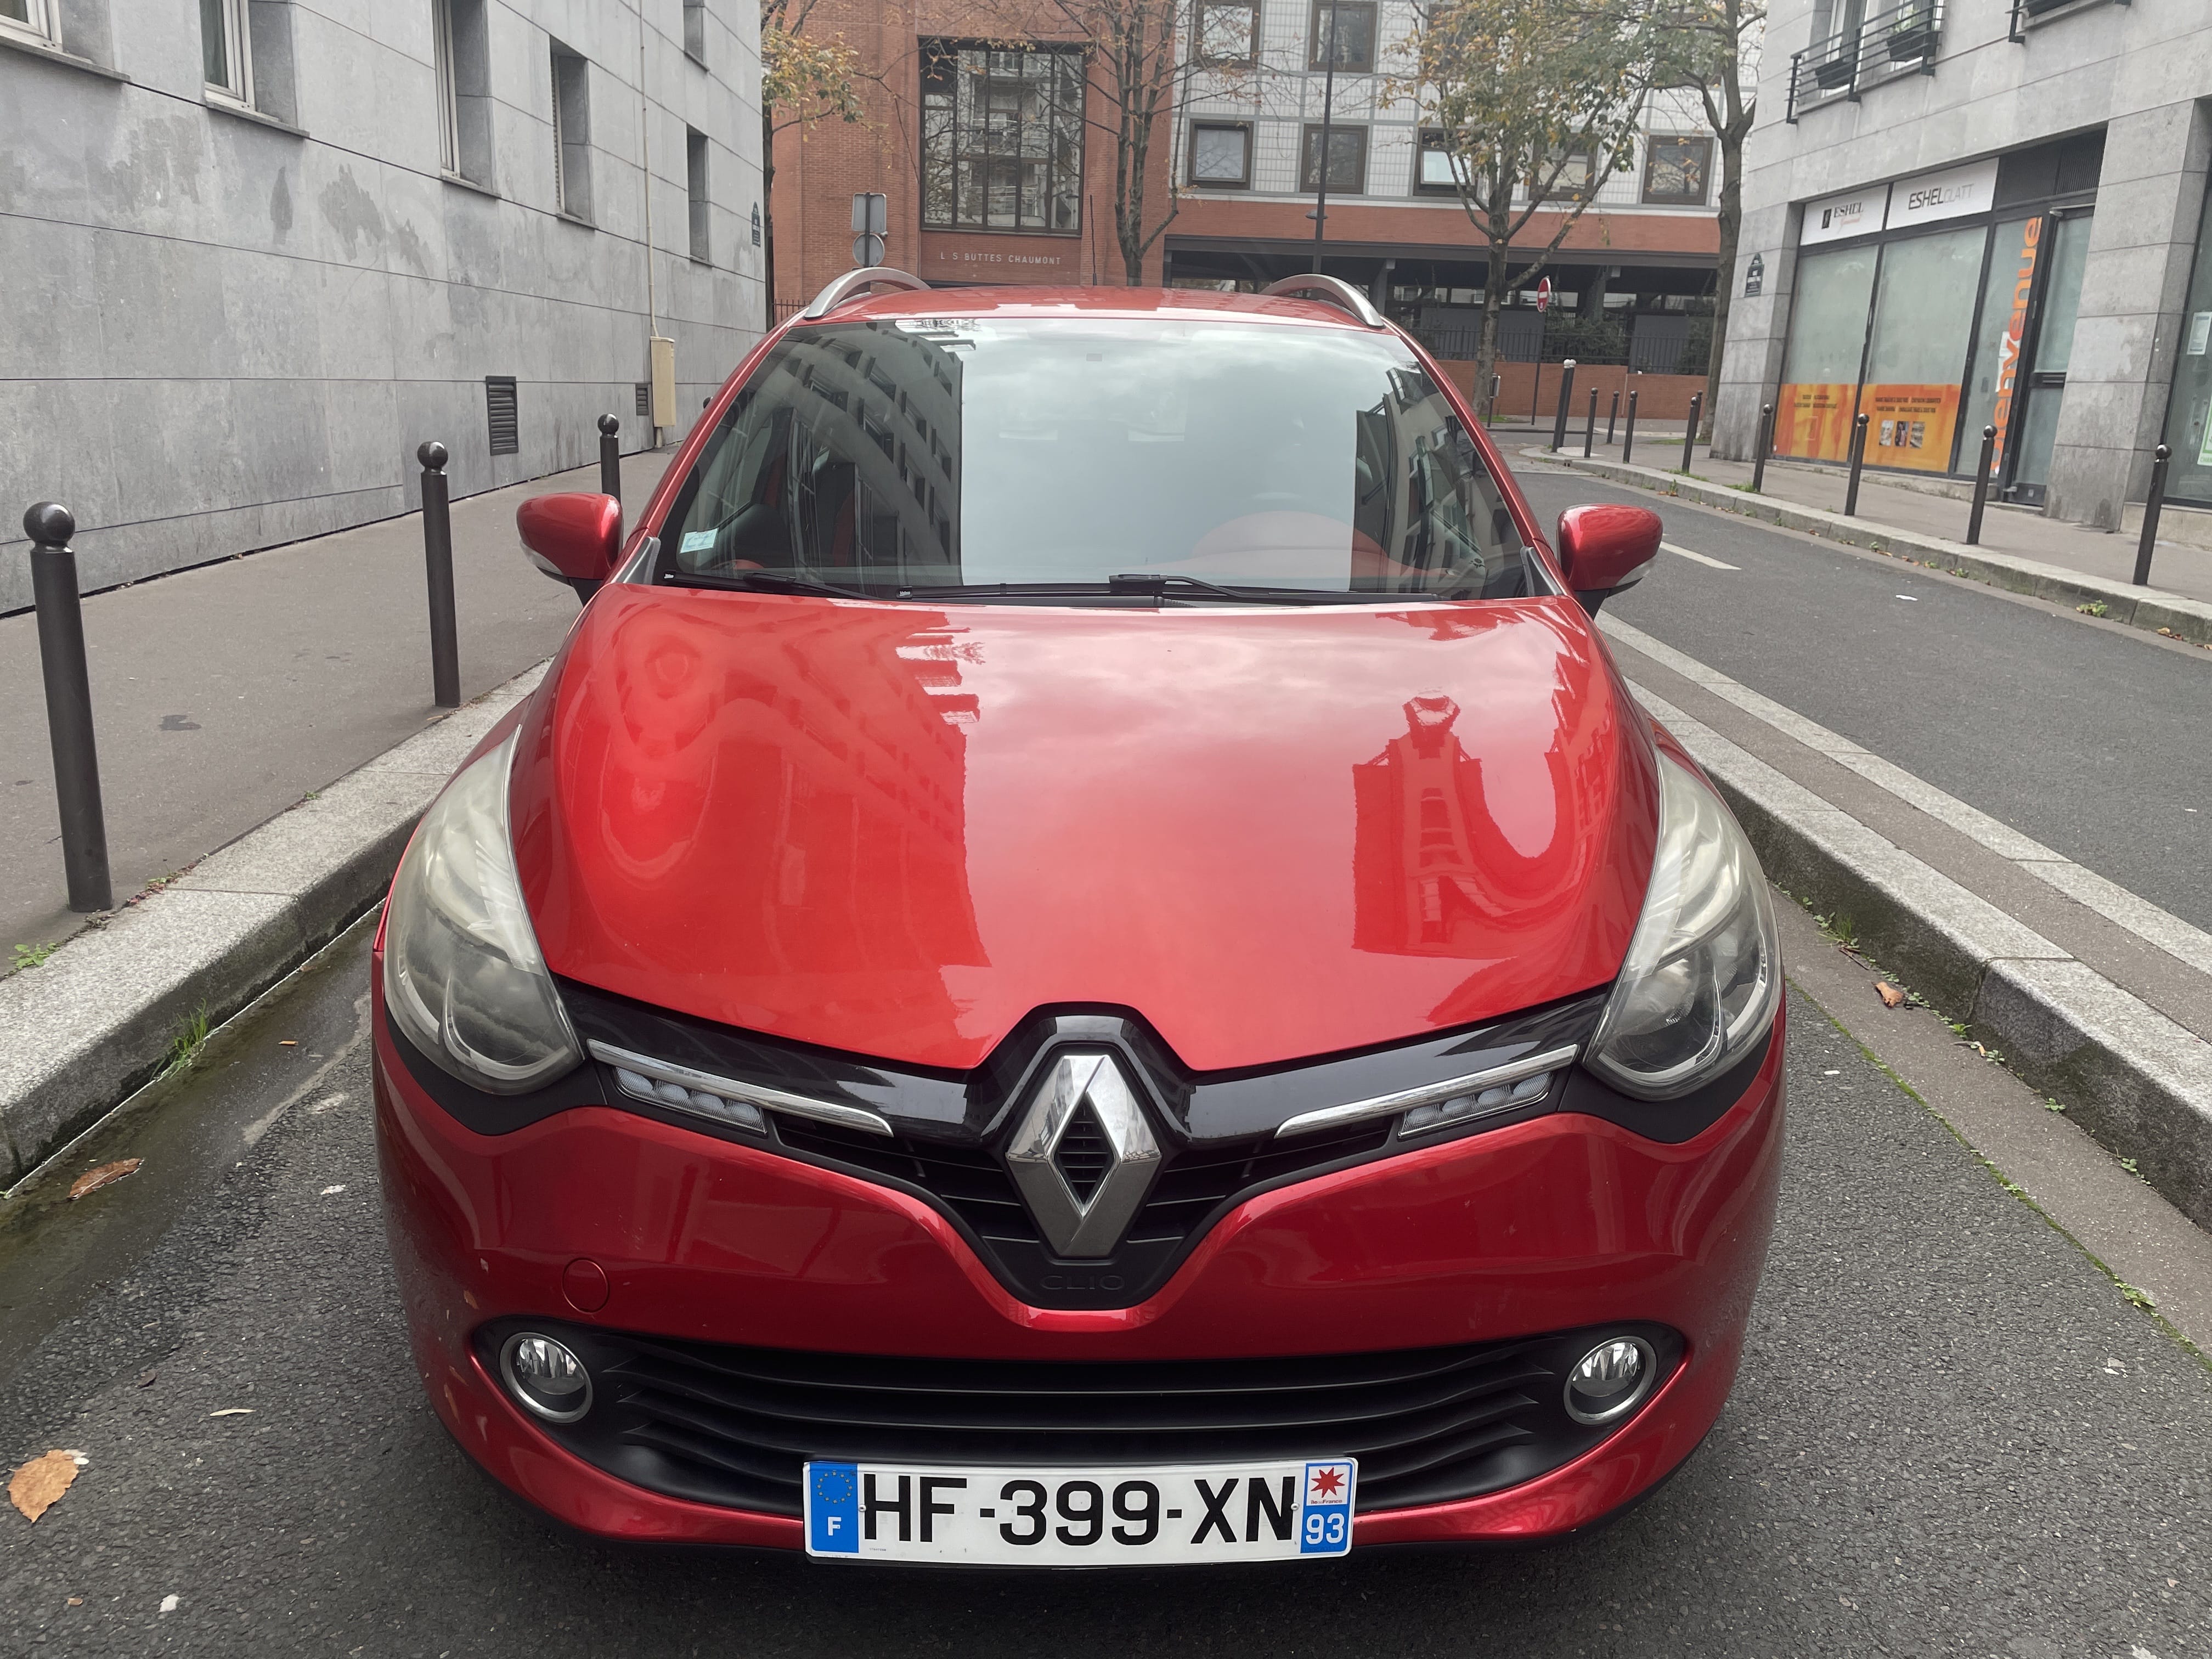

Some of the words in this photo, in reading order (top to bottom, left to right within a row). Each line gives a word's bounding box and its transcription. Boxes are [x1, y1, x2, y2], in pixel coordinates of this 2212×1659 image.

[1834, 201, 1864, 218] ESHEL
[964, 252, 1002, 262] BUTTES
[1008, 255, 1061, 265] CHAUMONT
[1041, 1275, 1124, 1290] CLIO
[864, 1473, 1296, 1546] HF-399-XN
[827, 1516, 842, 1536] F
[1306, 1513, 1345, 1545] 93
